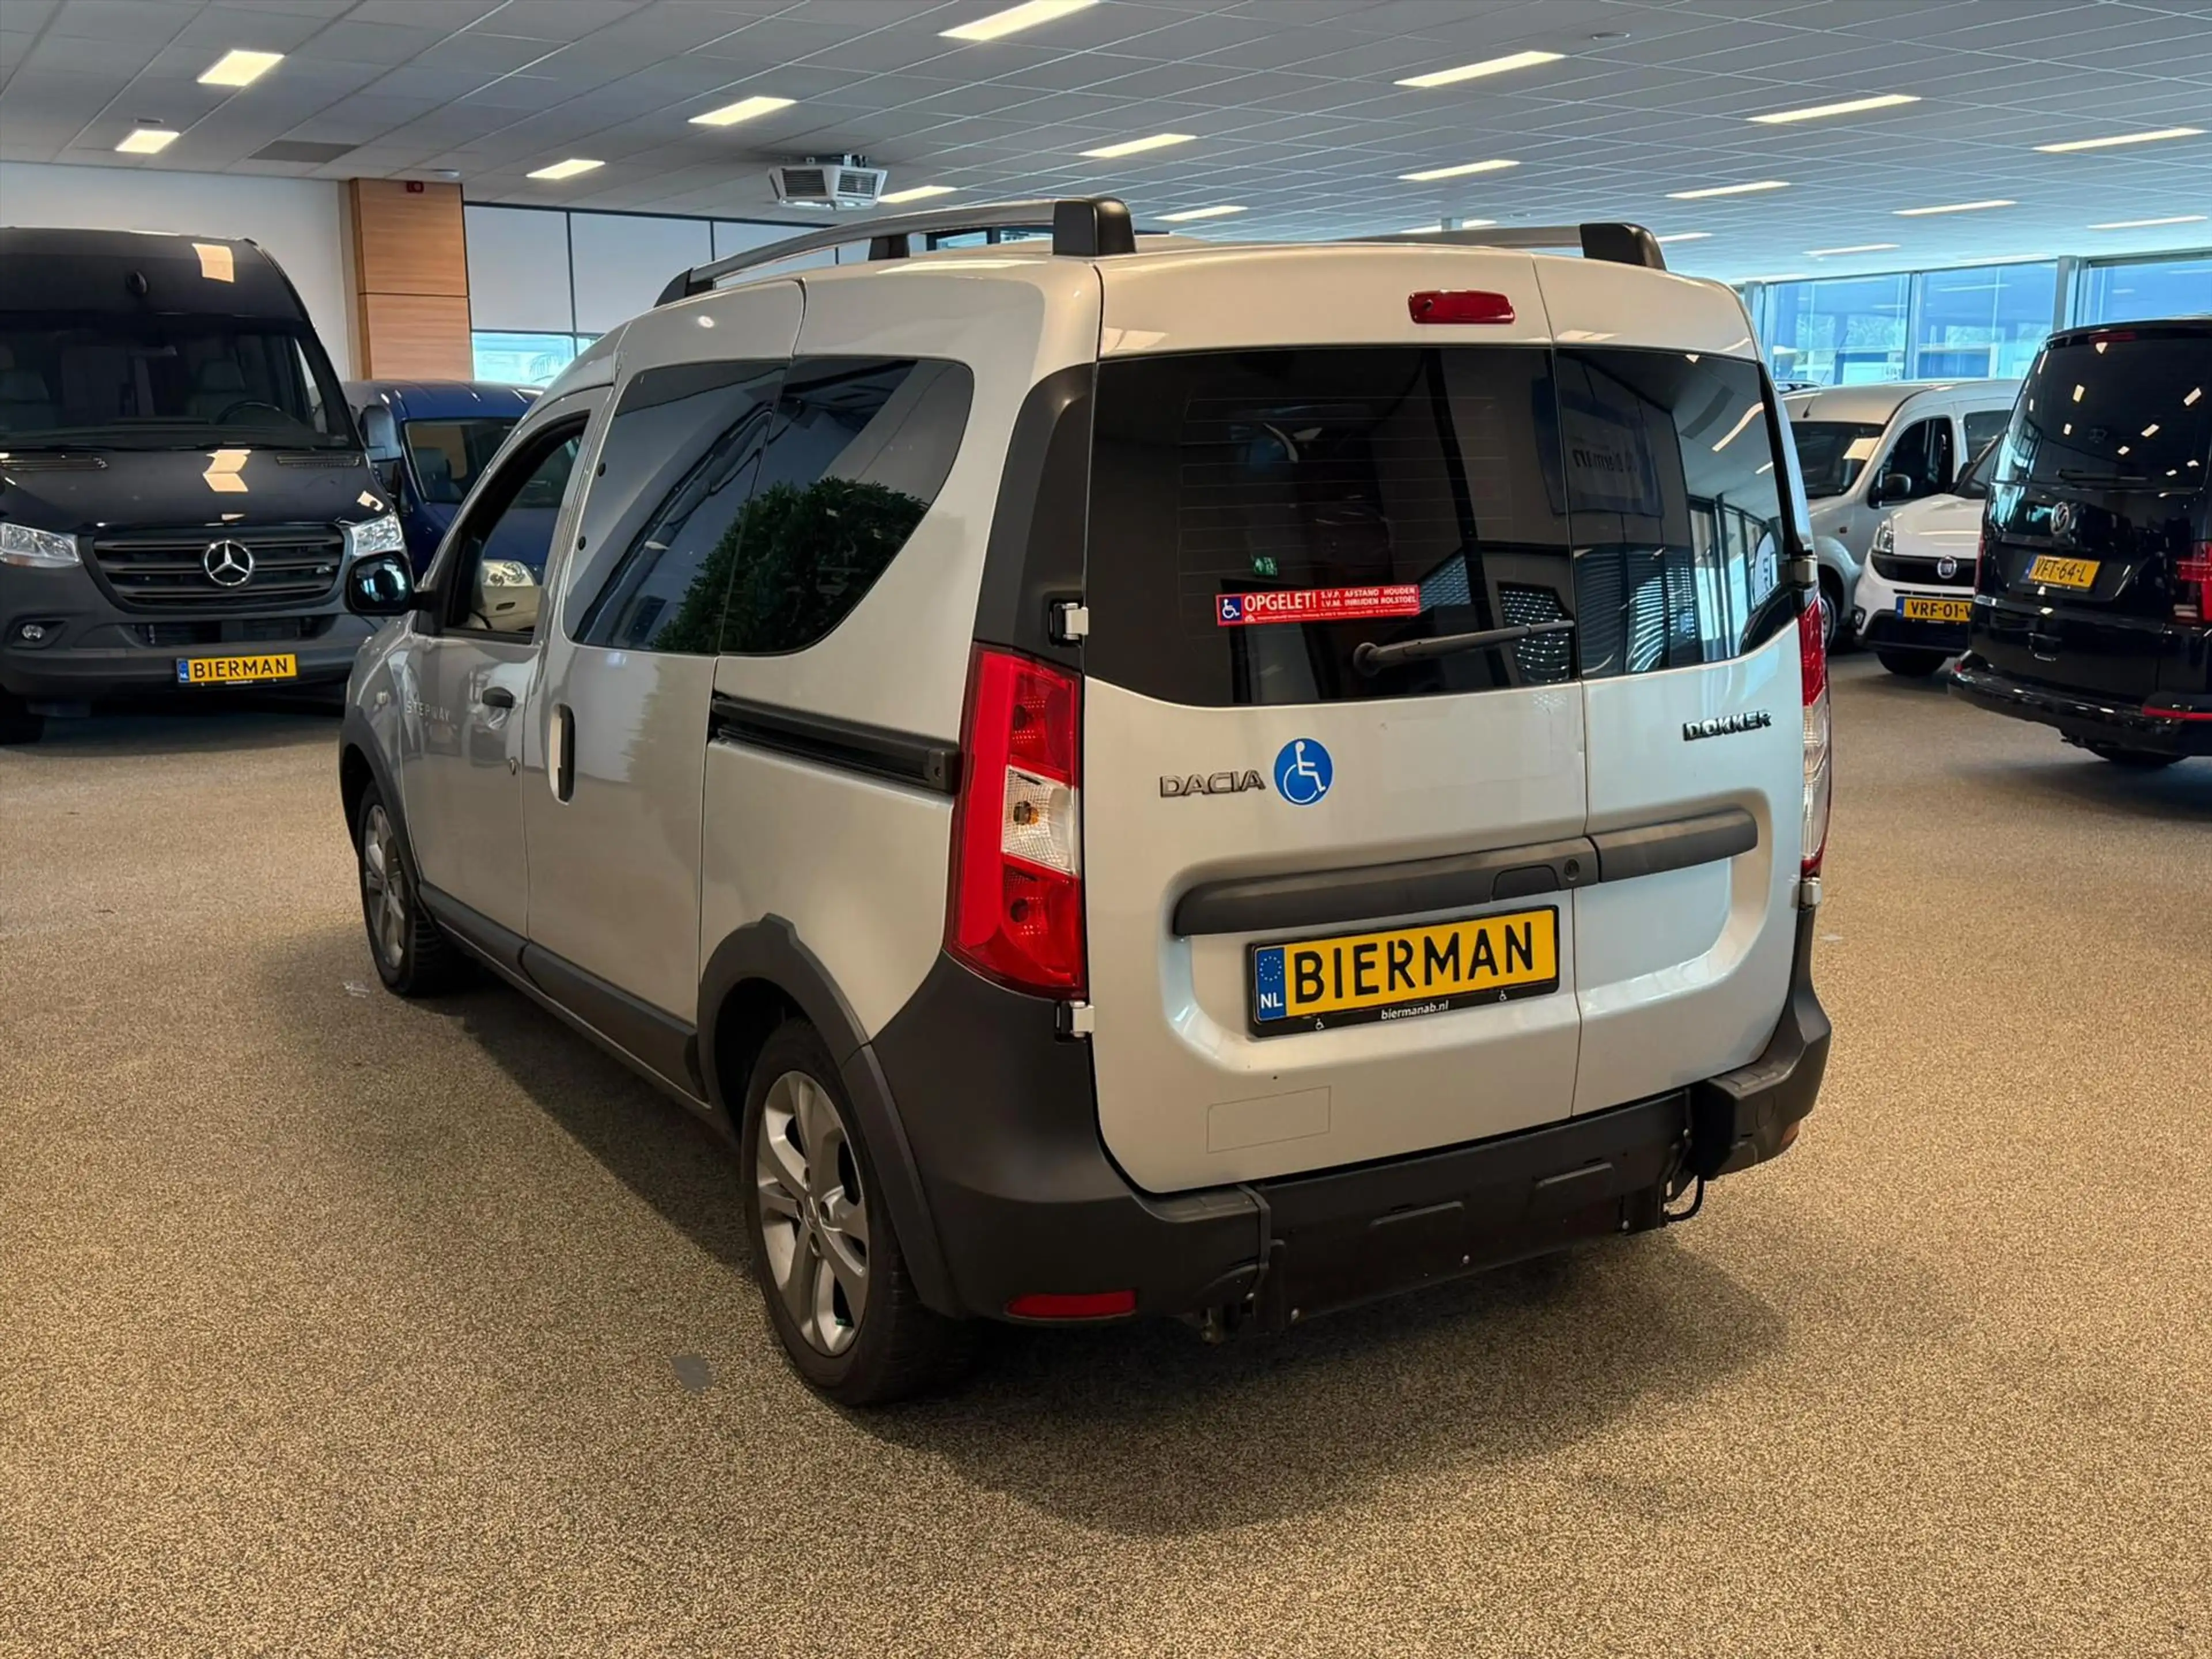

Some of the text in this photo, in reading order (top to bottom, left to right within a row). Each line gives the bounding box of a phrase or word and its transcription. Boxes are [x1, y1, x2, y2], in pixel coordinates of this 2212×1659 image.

[2035, 558, 2087, 582] VFT-64-L
[1244, 592, 1316, 611] OPGELET!
[1344, 589, 1379, 597] AFSTAND
[194, 657, 287, 678] BIERMAN
[1682, 709, 1772, 741] DOKKER
[1160, 770, 1266, 798] DACIA
[1260, 922, 1533, 1009] NL BIERMAN
[1381, 999, 1449, 1020] biermanab.nl
